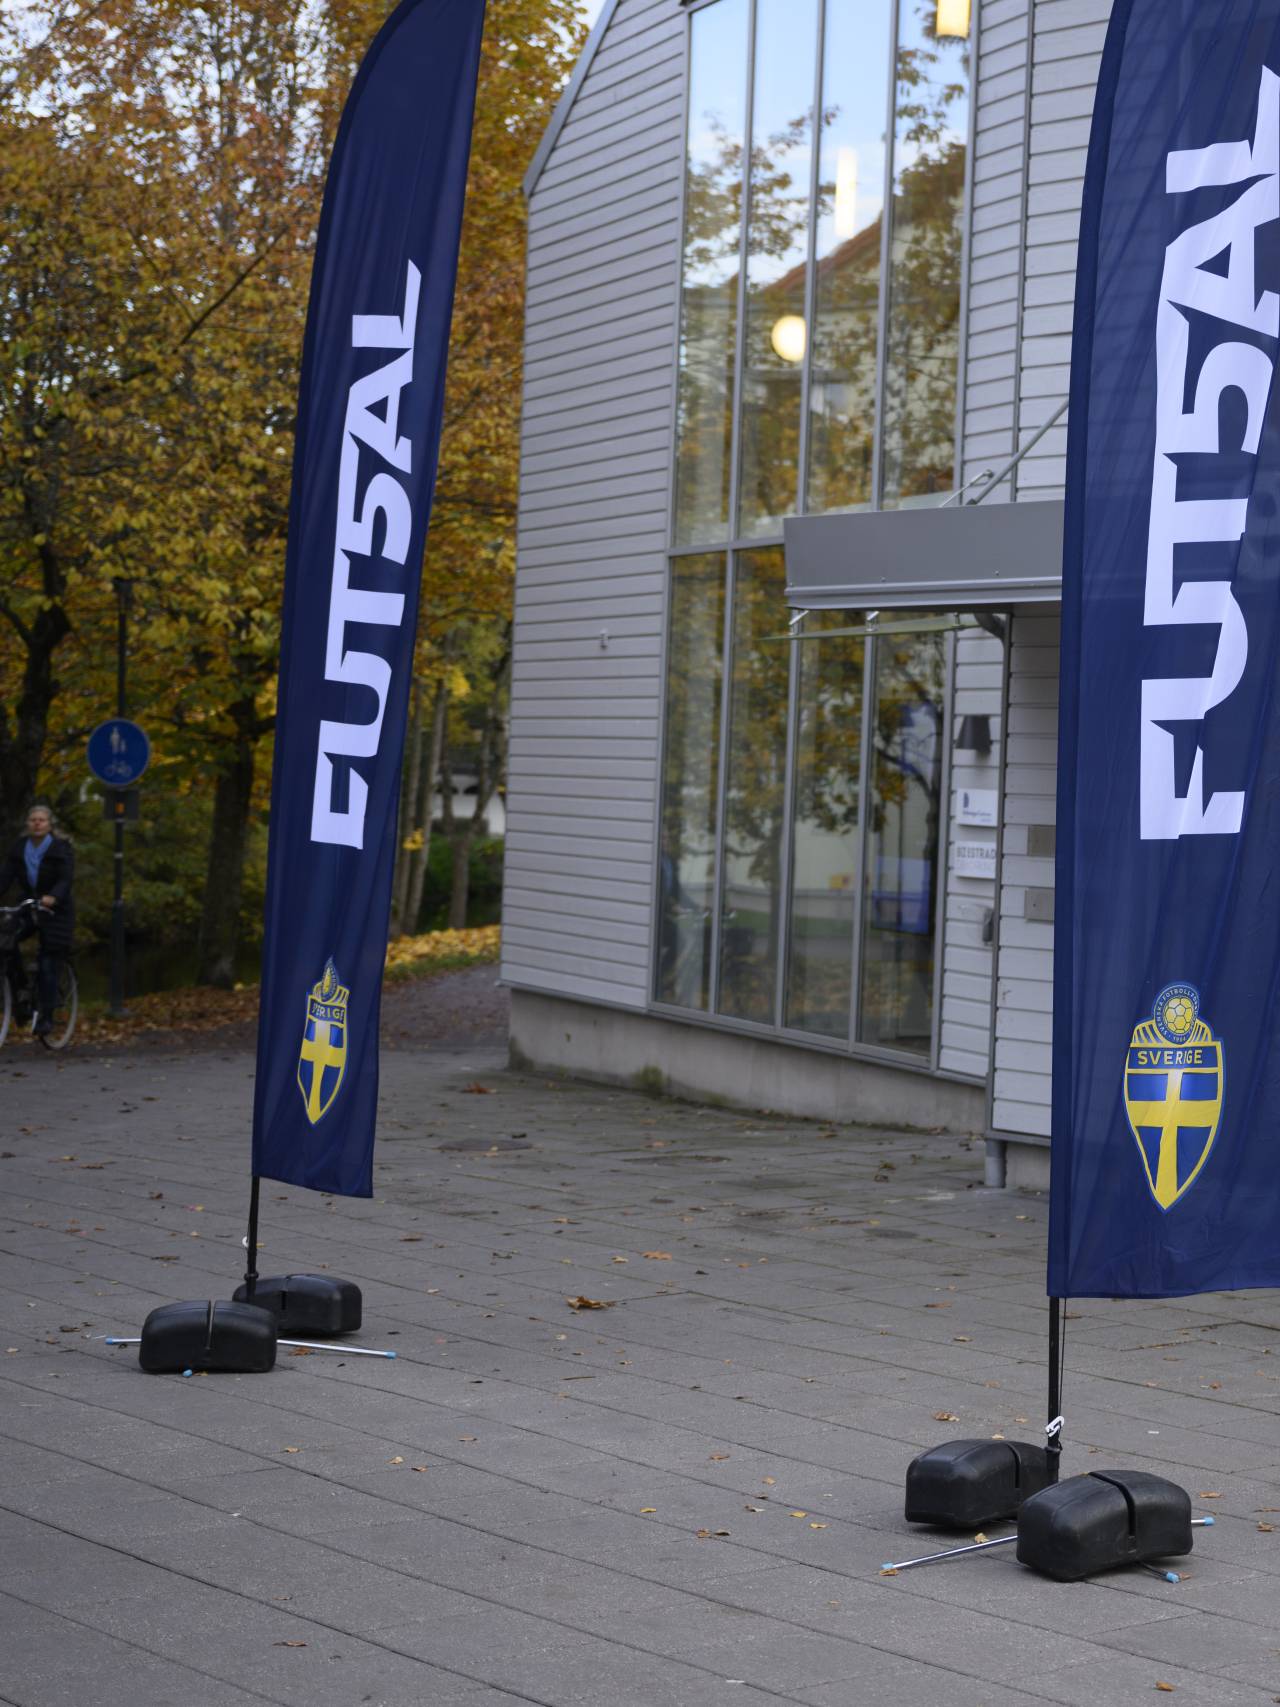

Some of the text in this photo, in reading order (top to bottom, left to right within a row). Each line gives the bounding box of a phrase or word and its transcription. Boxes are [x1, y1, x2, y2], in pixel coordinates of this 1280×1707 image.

[310, 257, 422, 850] FUTSAL
[1140, 63, 1280, 840] FUTSAL
[1137, 1049, 1203, 1066] SVERIGE
